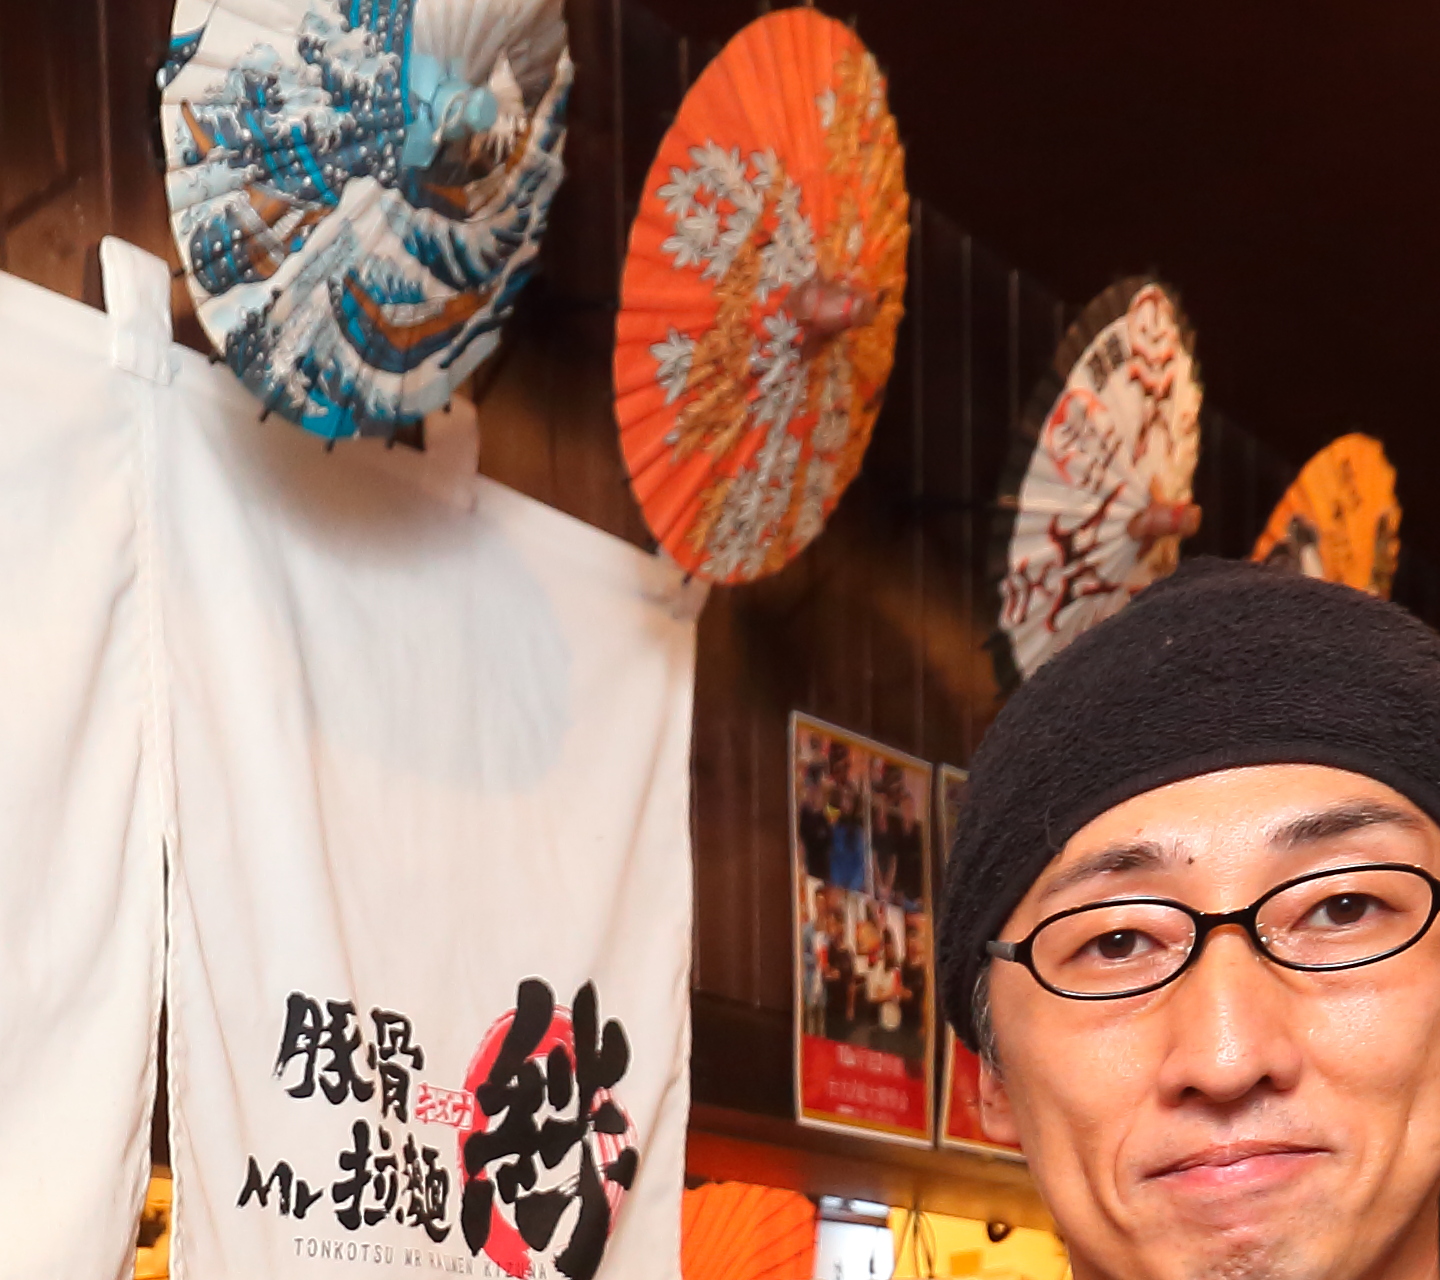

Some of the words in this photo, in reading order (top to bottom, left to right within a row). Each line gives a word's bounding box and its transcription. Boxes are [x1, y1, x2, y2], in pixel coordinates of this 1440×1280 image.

[272, 991, 423, 1123] 豚骨
[293, 1237, 394, 1265] TONKOTSU
[404, 1248, 422, 1268] MR
